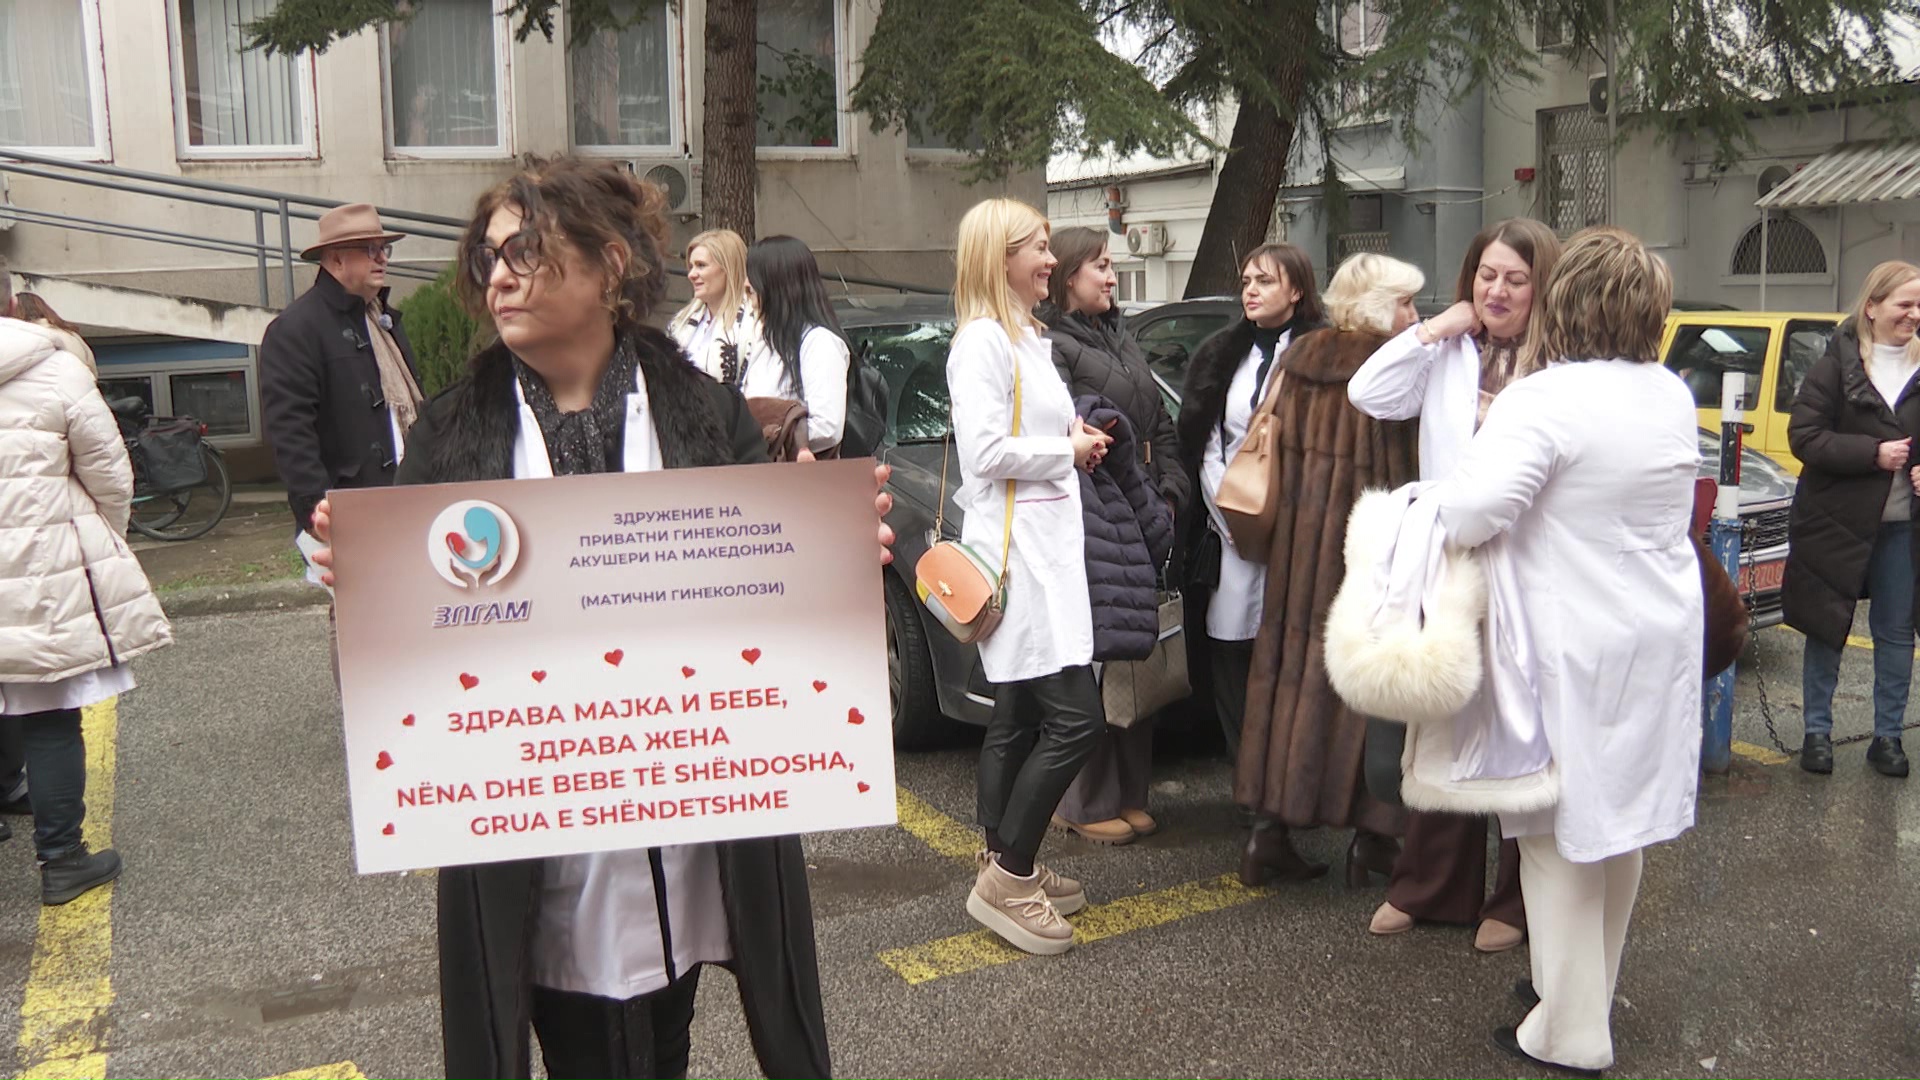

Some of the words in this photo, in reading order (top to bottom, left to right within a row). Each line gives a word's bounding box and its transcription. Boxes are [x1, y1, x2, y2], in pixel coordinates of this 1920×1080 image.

[613, 506, 714, 526] ЗДРУЖЕНИЕ
[718, 504, 743, 518] НА
[579, 530, 669, 548] ПРИВАТНИ
[673, 522, 783, 541] ГИНЕКОЛОЗИ
[569, 552, 650, 568] АКУШЕРИ
[654, 550, 678, 562] НА
[682, 541, 795, 560] МАКЕДОНИЈА
[580, 590, 667, 610] (МАТИЧНИ
[671, 581, 785, 601] ГИНЕКОЛОЗИ)
[447, 704, 566, 735] ЗДРАВА
[574, 695, 673, 723] МАЈКА
[681, 693, 700, 714] И
[709, 687, 788, 712] БЕБЕ,
[520, 733, 637, 764] ЗДРАВА
[644, 726, 730, 751] ЖЕНА
[397, 781, 478, 808] NËNA
[484, 776, 545, 800] DHE
[552, 769, 626, 795] BEBE
[632, 761, 667, 787] TË
[674, 750, 855, 784] SHËNDOSHA,
[470, 811, 550, 837] GRUA
[558, 808, 574, 829] E
[582, 789, 790, 827] SHËNDETSHME
